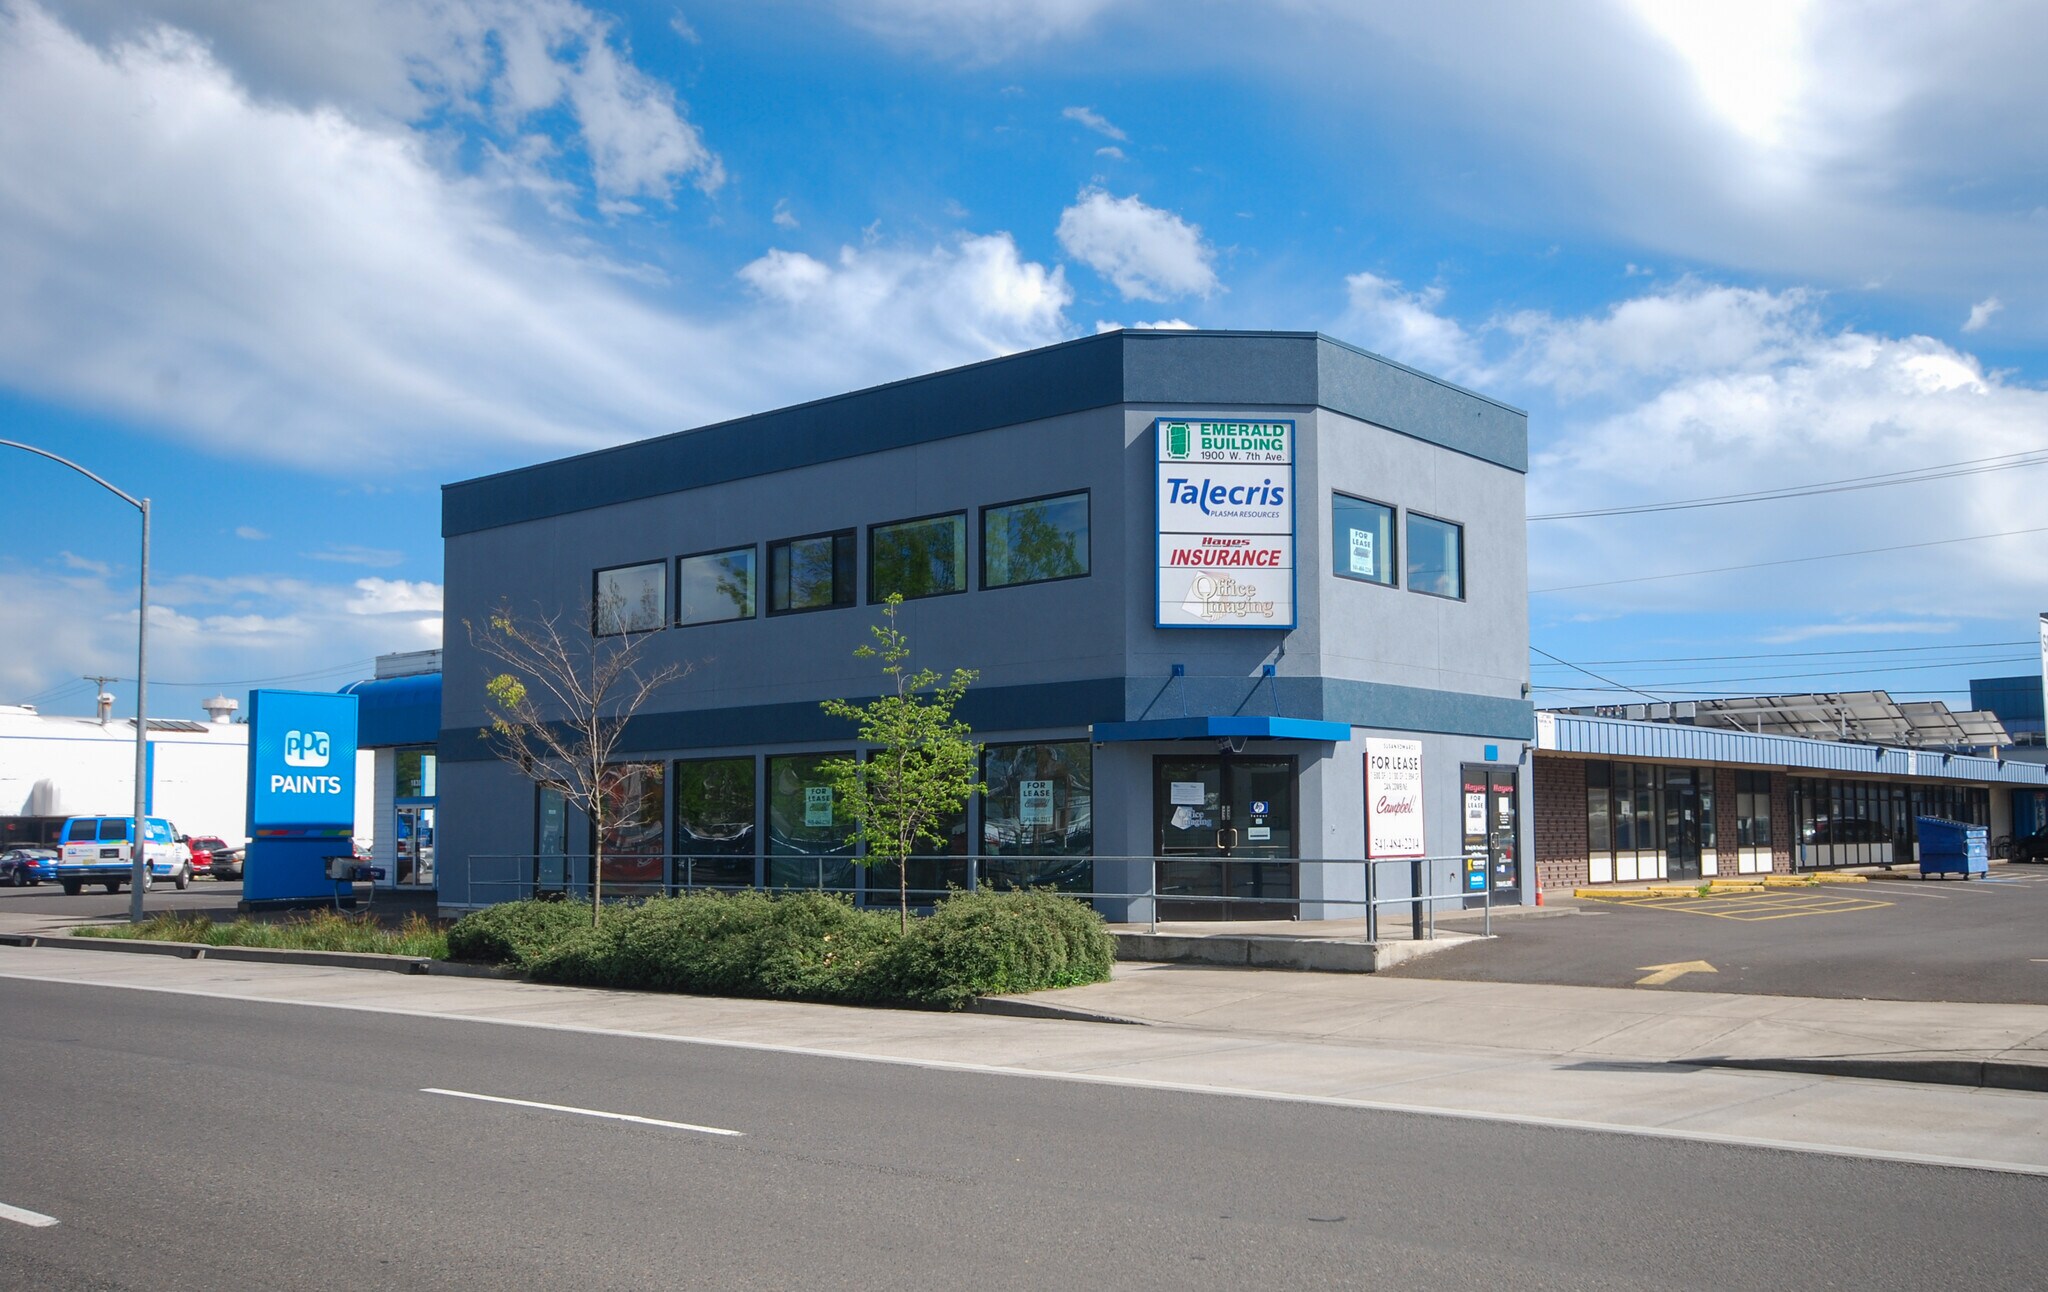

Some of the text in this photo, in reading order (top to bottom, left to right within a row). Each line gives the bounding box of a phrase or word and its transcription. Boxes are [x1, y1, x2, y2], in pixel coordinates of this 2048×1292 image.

[1200, 424, 1285, 437] EMERALD
[1201, 438, 1283, 451] BUILDING
[1201, 451, 1285, 461] 1900 W. 7th Ave.
[1167, 478, 1284, 516] Talecris
[1202, 537, 1250, 547] Hayes
[1355, 531, 1368, 539] FOR
[1352, 538, 1371, 548] LEASE
[1170, 549, 1281, 566] INSURANCE
[1192, 575, 1256, 600] Office
[1201, 596, 1273, 618] Imaging
[287, 733, 328, 760] PPG
[1371, 756, 1418, 770] FOR LEASE
[271, 775, 341, 794] PAINTS
